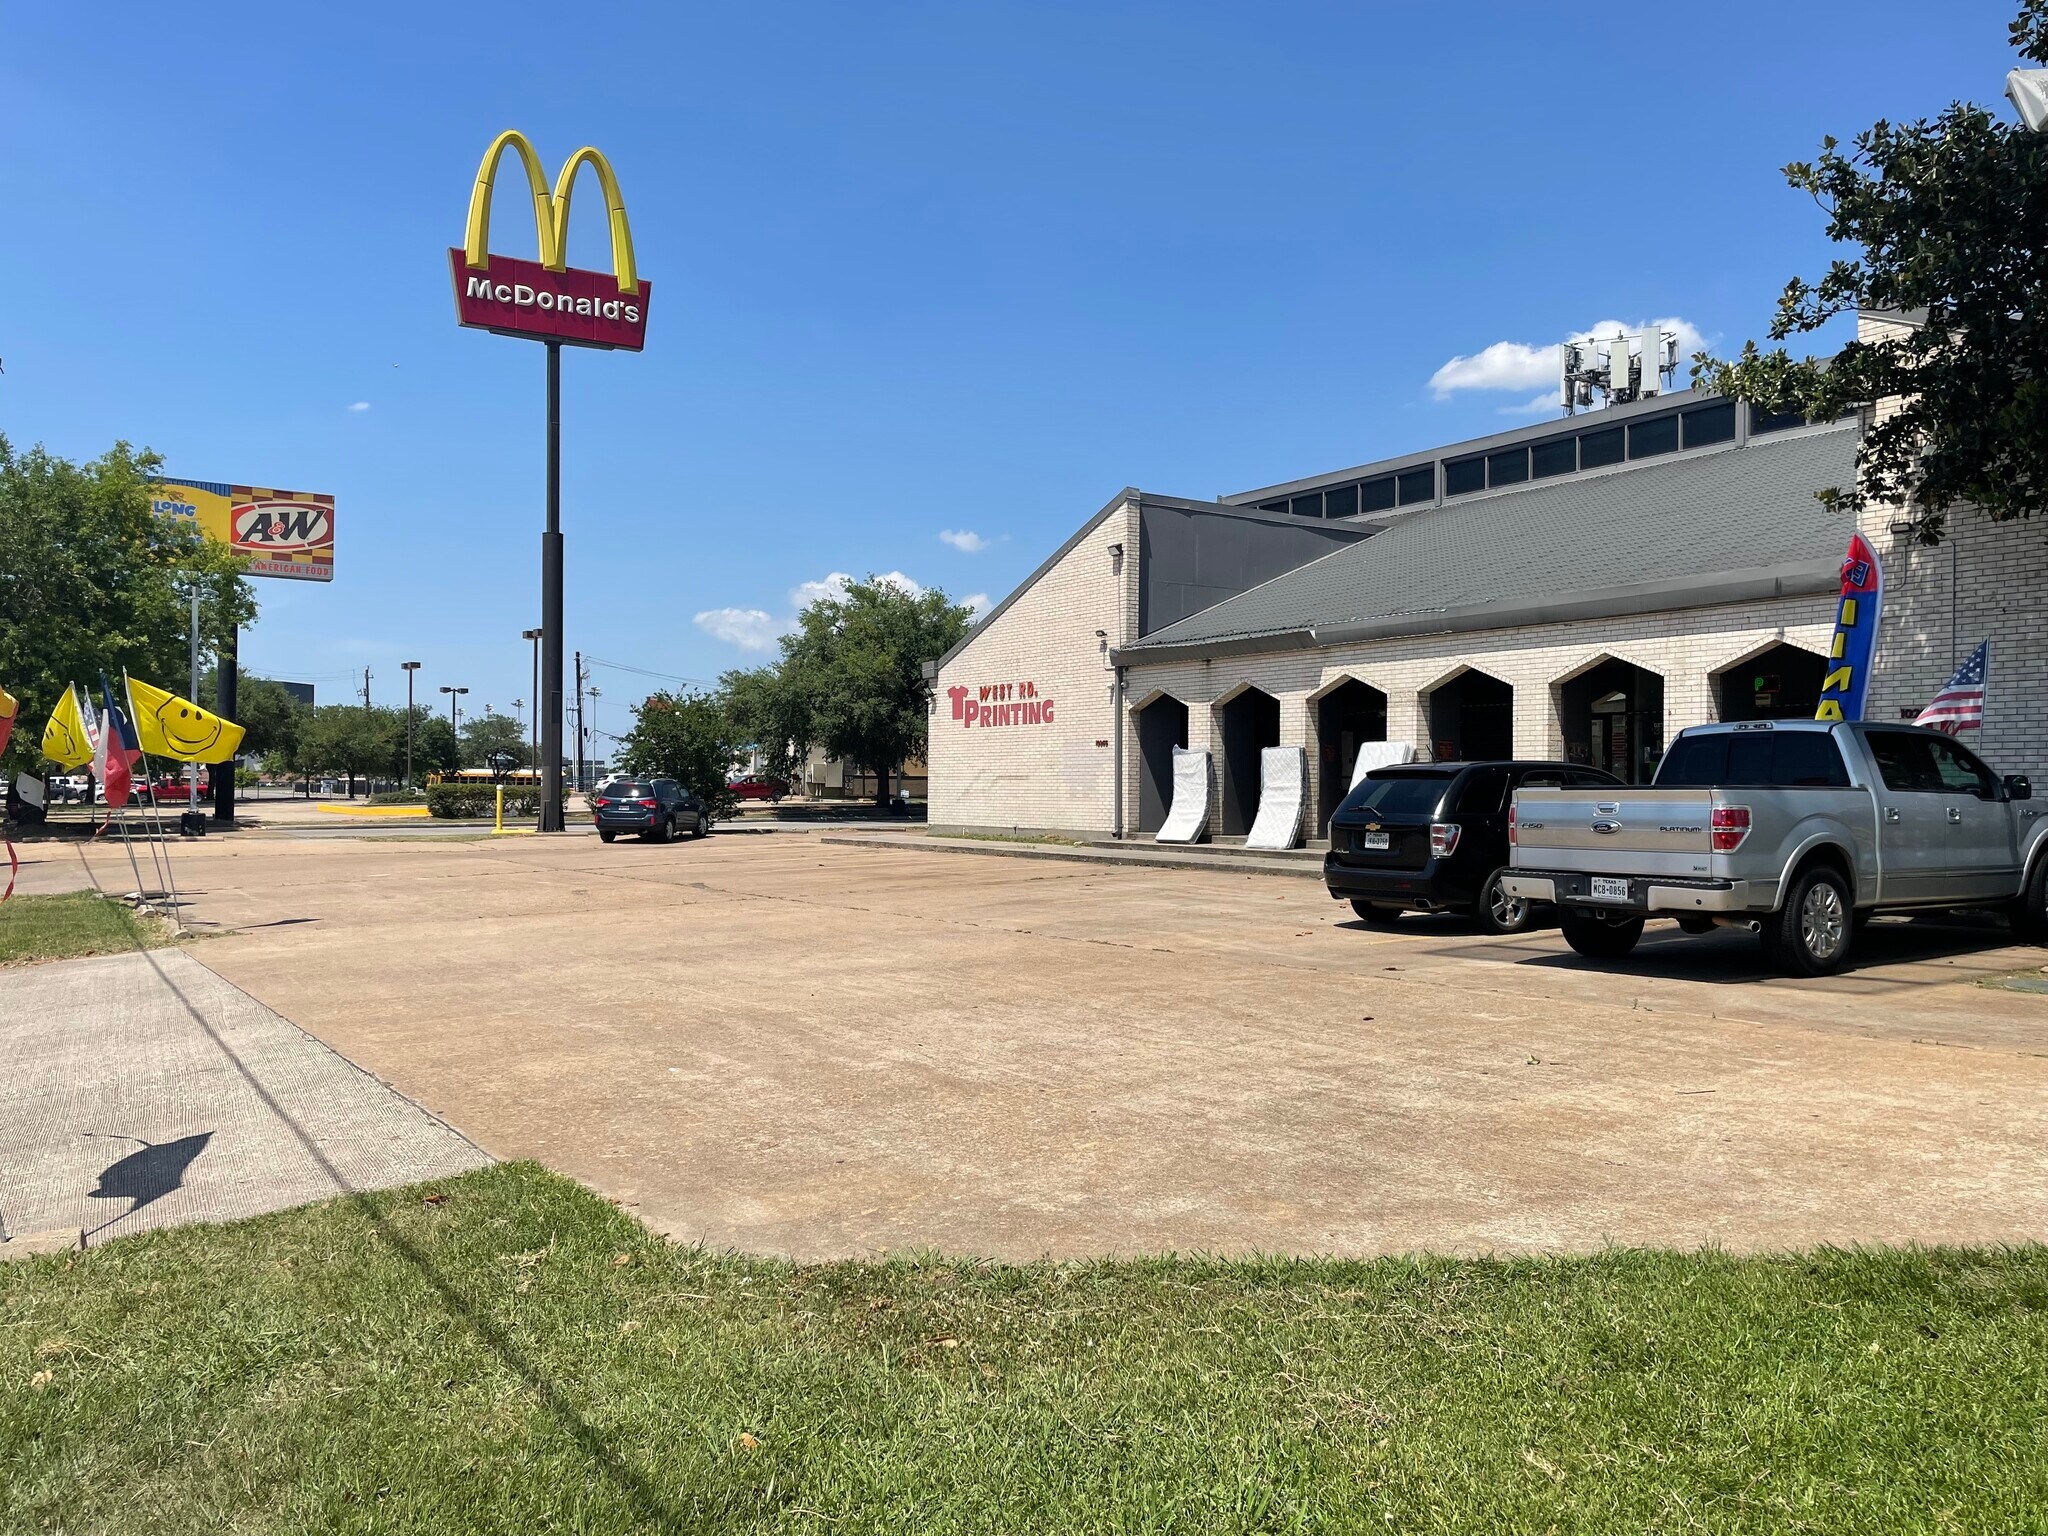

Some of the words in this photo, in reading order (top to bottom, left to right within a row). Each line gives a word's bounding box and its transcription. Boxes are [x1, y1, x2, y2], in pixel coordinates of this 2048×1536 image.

[465, 276, 641, 324] McDonald's
[153, 500, 197, 517] LONG
[239, 510, 327, 543] A&W
[255, 562, 301, 574] AMERICAN
[305, 566, 329, 576] FOOD
[979, 683, 1013, 702] WEST
